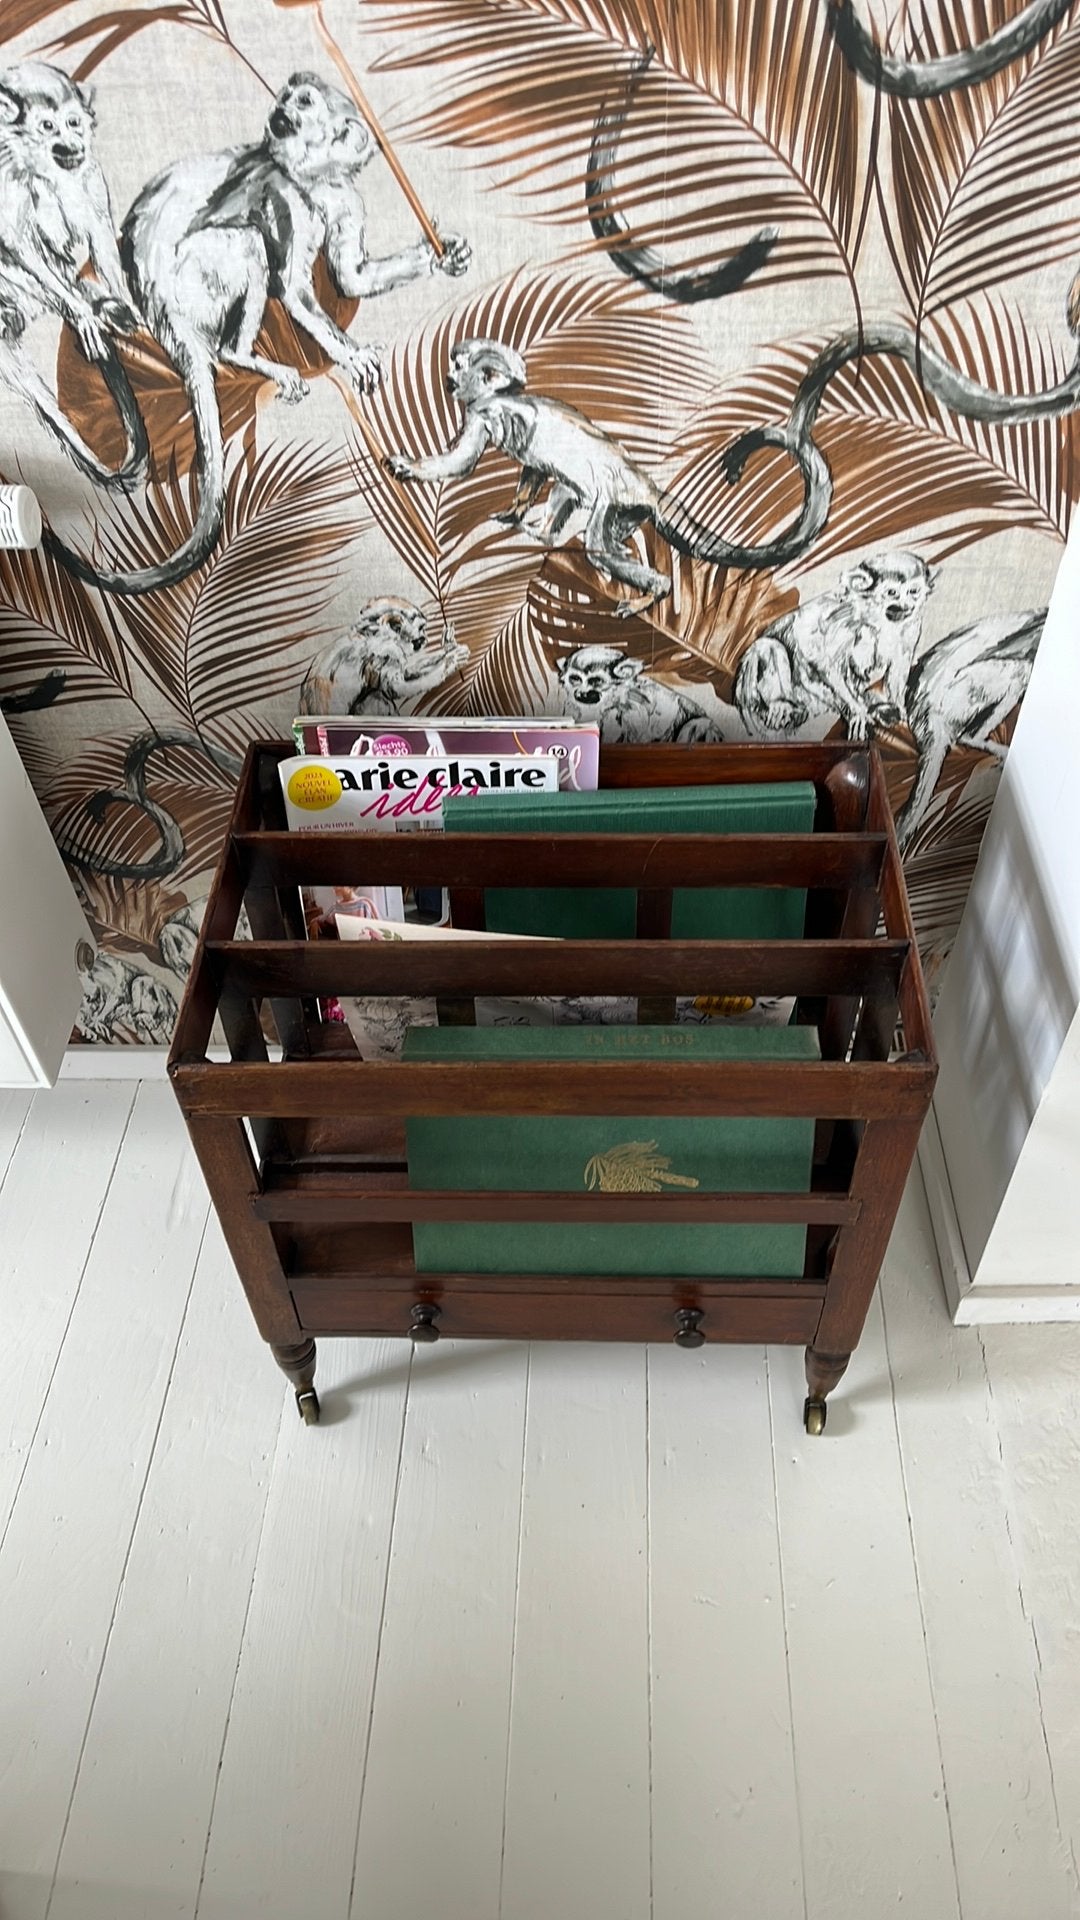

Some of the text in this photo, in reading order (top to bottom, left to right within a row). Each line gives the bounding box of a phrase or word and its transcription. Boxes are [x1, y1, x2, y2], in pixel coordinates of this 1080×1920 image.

[373, 741, 407, 751] Slechts
[552, 747, 565, 756] 14
[335, 762, 419, 791] arie
[427, 760, 547, 789] claire
[661, 1033, 694, 1046] BOS
